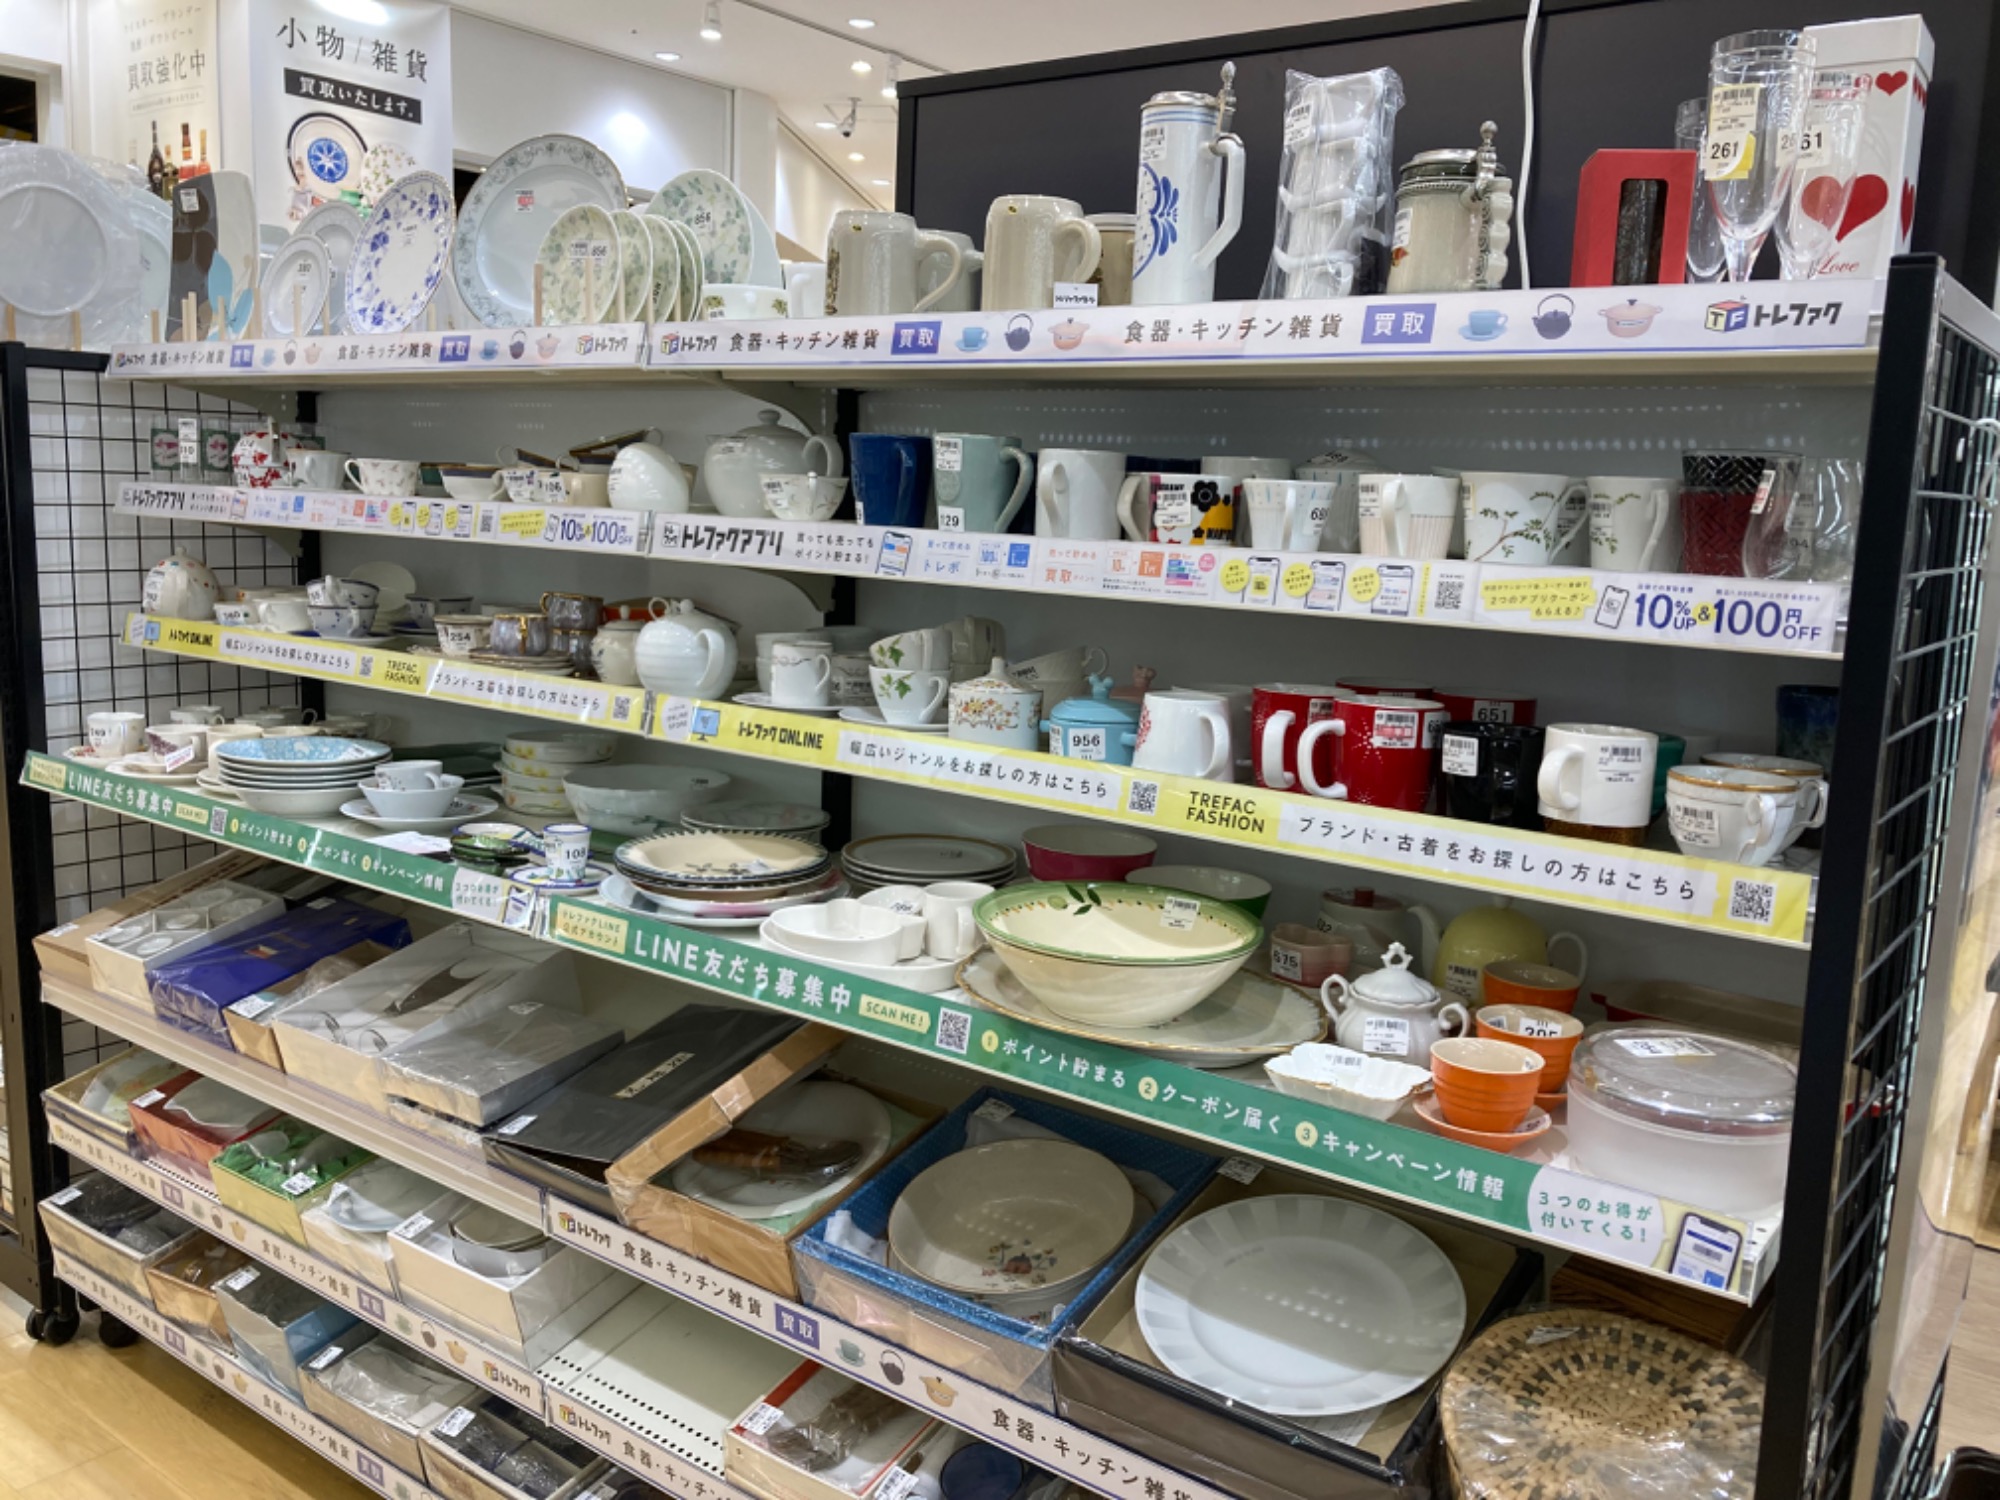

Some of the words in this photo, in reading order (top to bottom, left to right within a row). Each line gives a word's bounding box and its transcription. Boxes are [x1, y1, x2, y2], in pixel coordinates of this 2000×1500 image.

[127, 48, 206, 92] 買取強化中
[299, 76, 414, 118] 買取いたします。
[1711, 141, 1740, 160] 261
[1819, 251, 1860, 275] Love
[1124, 311, 1344, 344] 食器・キッチン雑貨
[1371, 311, 1428, 337] 買取
[1752, 300, 1841, 328] トレファク
[336, 340, 433, 360] 食器・キッチン雑貨
[593, 335, 628, 352] トレファク
[680, 334, 718, 352] トレファク
[729, 326, 879, 353] 食器・キッチン雑貨
[898, 323, 935, 348] 買取
[682, 524, 784, 557] トレファクアプリ
[796, 532, 874, 549] 買っても売っても
[1673, 616, 1698, 630] UP
[1782, 624, 1823, 641] OFF
[1697, 605, 1711, 622] &
[1713, 598, 1803, 638] 100円
[225, 638, 351, 670] 幅広いジャンルをお探しの方はこちら
[384, 671, 421, 686] FASHION
[1477, 708, 1508, 722] 651
[738, 719, 778, 742] トレファク
[779, 728, 826, 749] ONLINE
[1071, 735, 1100, 747] 956
[849, 739, 1108, 799] 幅広いジャンルをお探しの方はこちら
[68, 770, 174, 818] LINE友だち募集中
[1189, 791, 1258, 815] TREFAC
[1186, 806, 1266, 834] FASHION
[1299, 816, 1695, 901] ブランド・古着をお探しの方はこちら
[634, 929, 852, 1015] LINE友だち募集中
[865, 1000, 898, 1020] SCAN
[1002, 1038, 1126, 1089] ポイント貯まる
[1161, 1083, 1280, 1134] クーポン届く
[1322, 1129, 1505, 1202] キャンペーン情報
[1538, 1191, 1652, 1221] 3つのお得が
[1540, 1210, 1647, 1243] 付いてくる!
[261, 1238, 350, 1298] 食器・キッチン雑貨
[576, 1220, 612, 1249] トレファク
[621, 1240, 763, 1319] 食器・キッチン雑貨
[779, 1309, 815, 1341] 買取
[499, 1370, 531, 1399] トレファク
[261, 1392, 350, 1460] 食器・キッチン雑貨
[577, 1416, 612, 1446] トレファク
